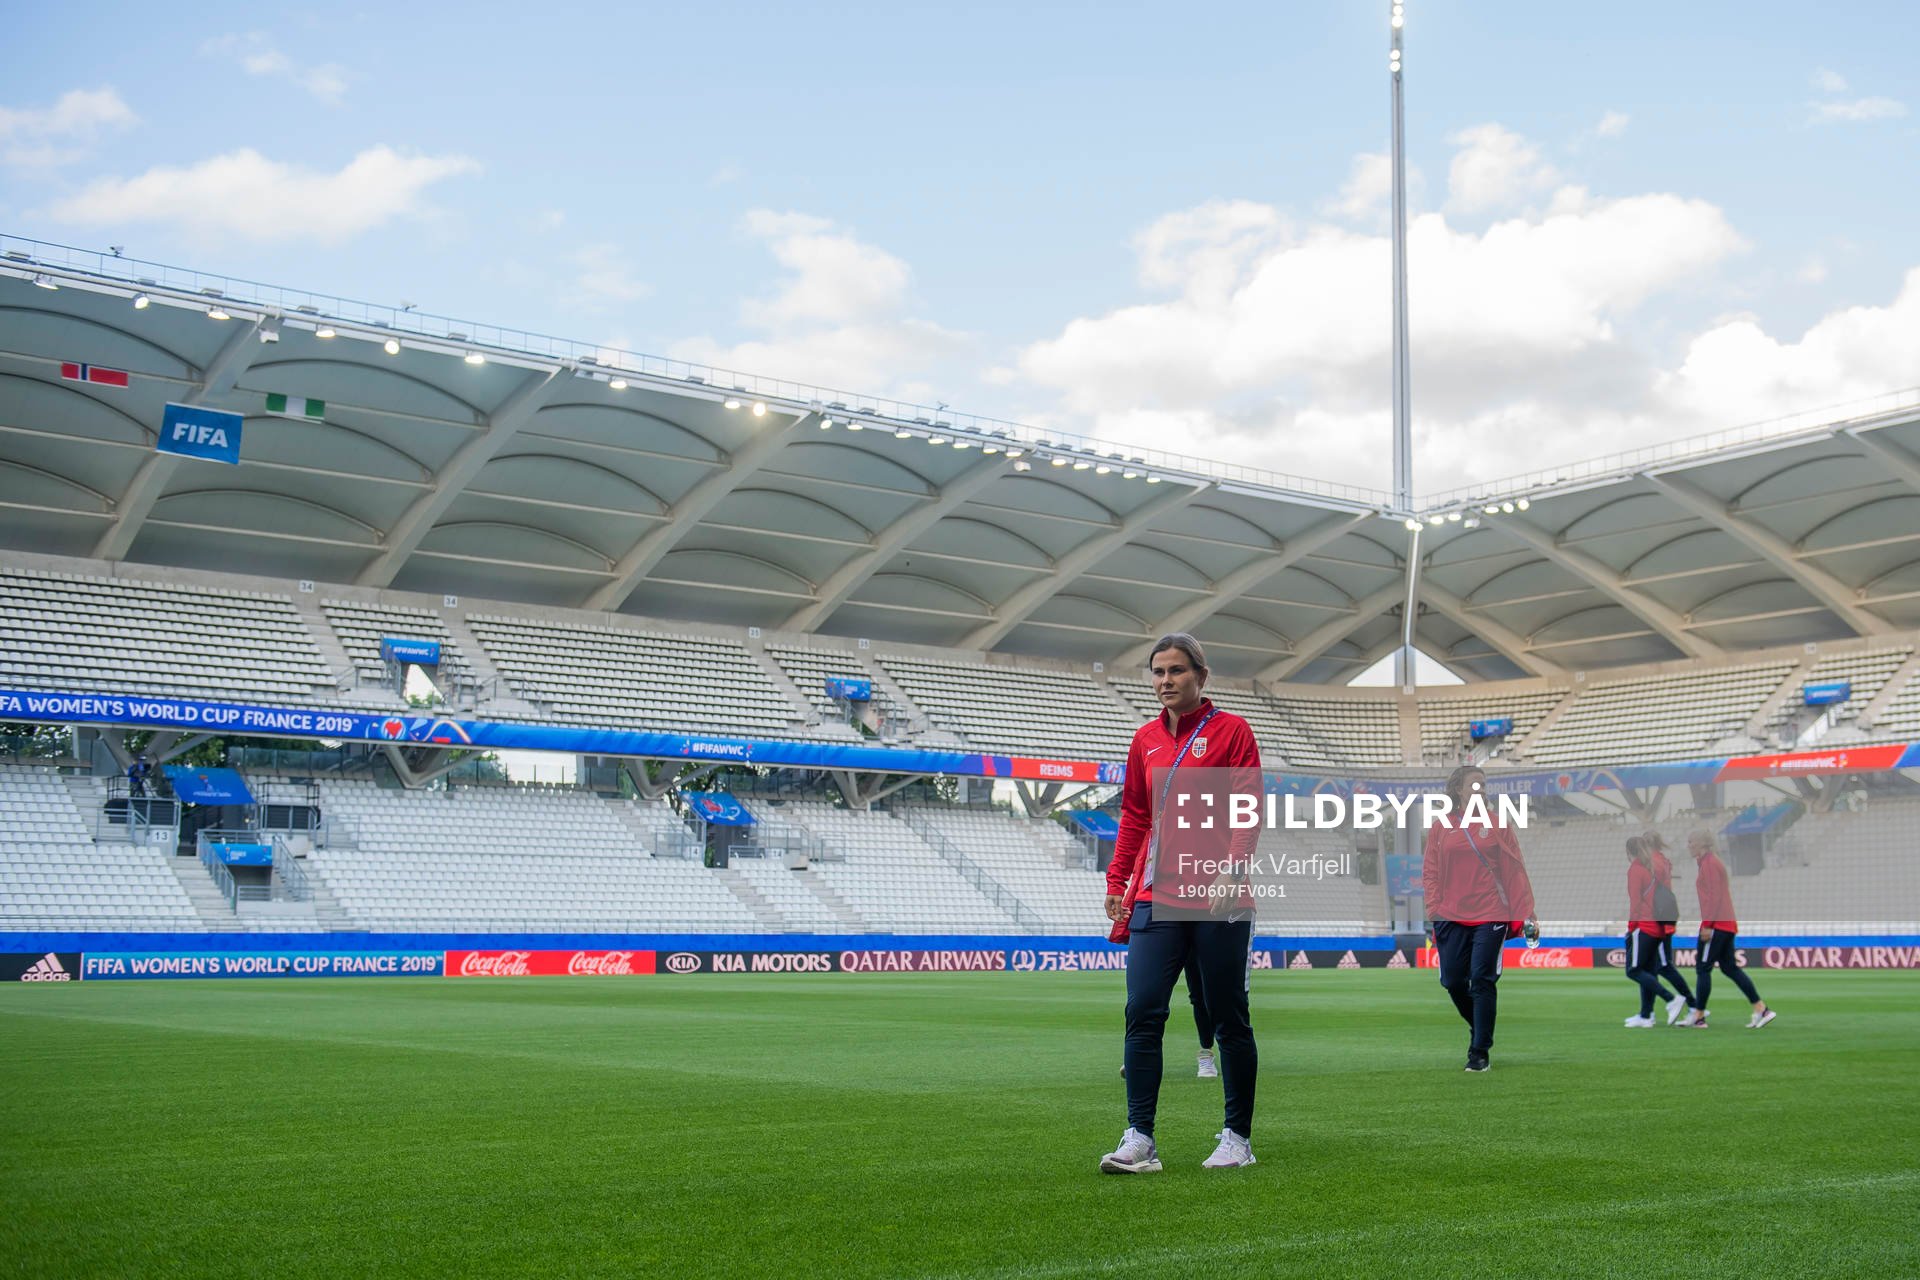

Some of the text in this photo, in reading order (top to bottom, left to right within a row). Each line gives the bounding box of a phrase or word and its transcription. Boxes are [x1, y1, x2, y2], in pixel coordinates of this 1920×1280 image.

[172, 422, 228, 448] FIFA
[27, 697, 124, 716] WOMEN'S
[128, 702, 198, 721] WORLD
[202, 707, 240, 724] CUP
[243, 710, 312, 730] FRANCE
[692, 743, 744, 756] #FIFAWWC
[1040, 763, 1074, 777] REIMS
[155, 831, 168, 841] 13
[87, 958, 125, 974] FIFA
[131, 957, 220, 975] WOMEN'S
[224, 957, 290, 973] WORLD
[293, 957, 329, 972] CUP
[333, 956, 398, 972] FRANCE
[460, 951, 532, 976] Coca-Cola
[567, 951, 634, 975] Coca-Cola
[712, 953, 832, 972] KIA MOTORS
[839, 950, 1006, 973] QATAR AIRWAYS
[1079, 951, 1128, 970] WAND
[1519, 949, 1573, 968] Coca-Cola
[1765, 946, 1843, 969] QATAR
[20, 972, 71, 982] adidas
